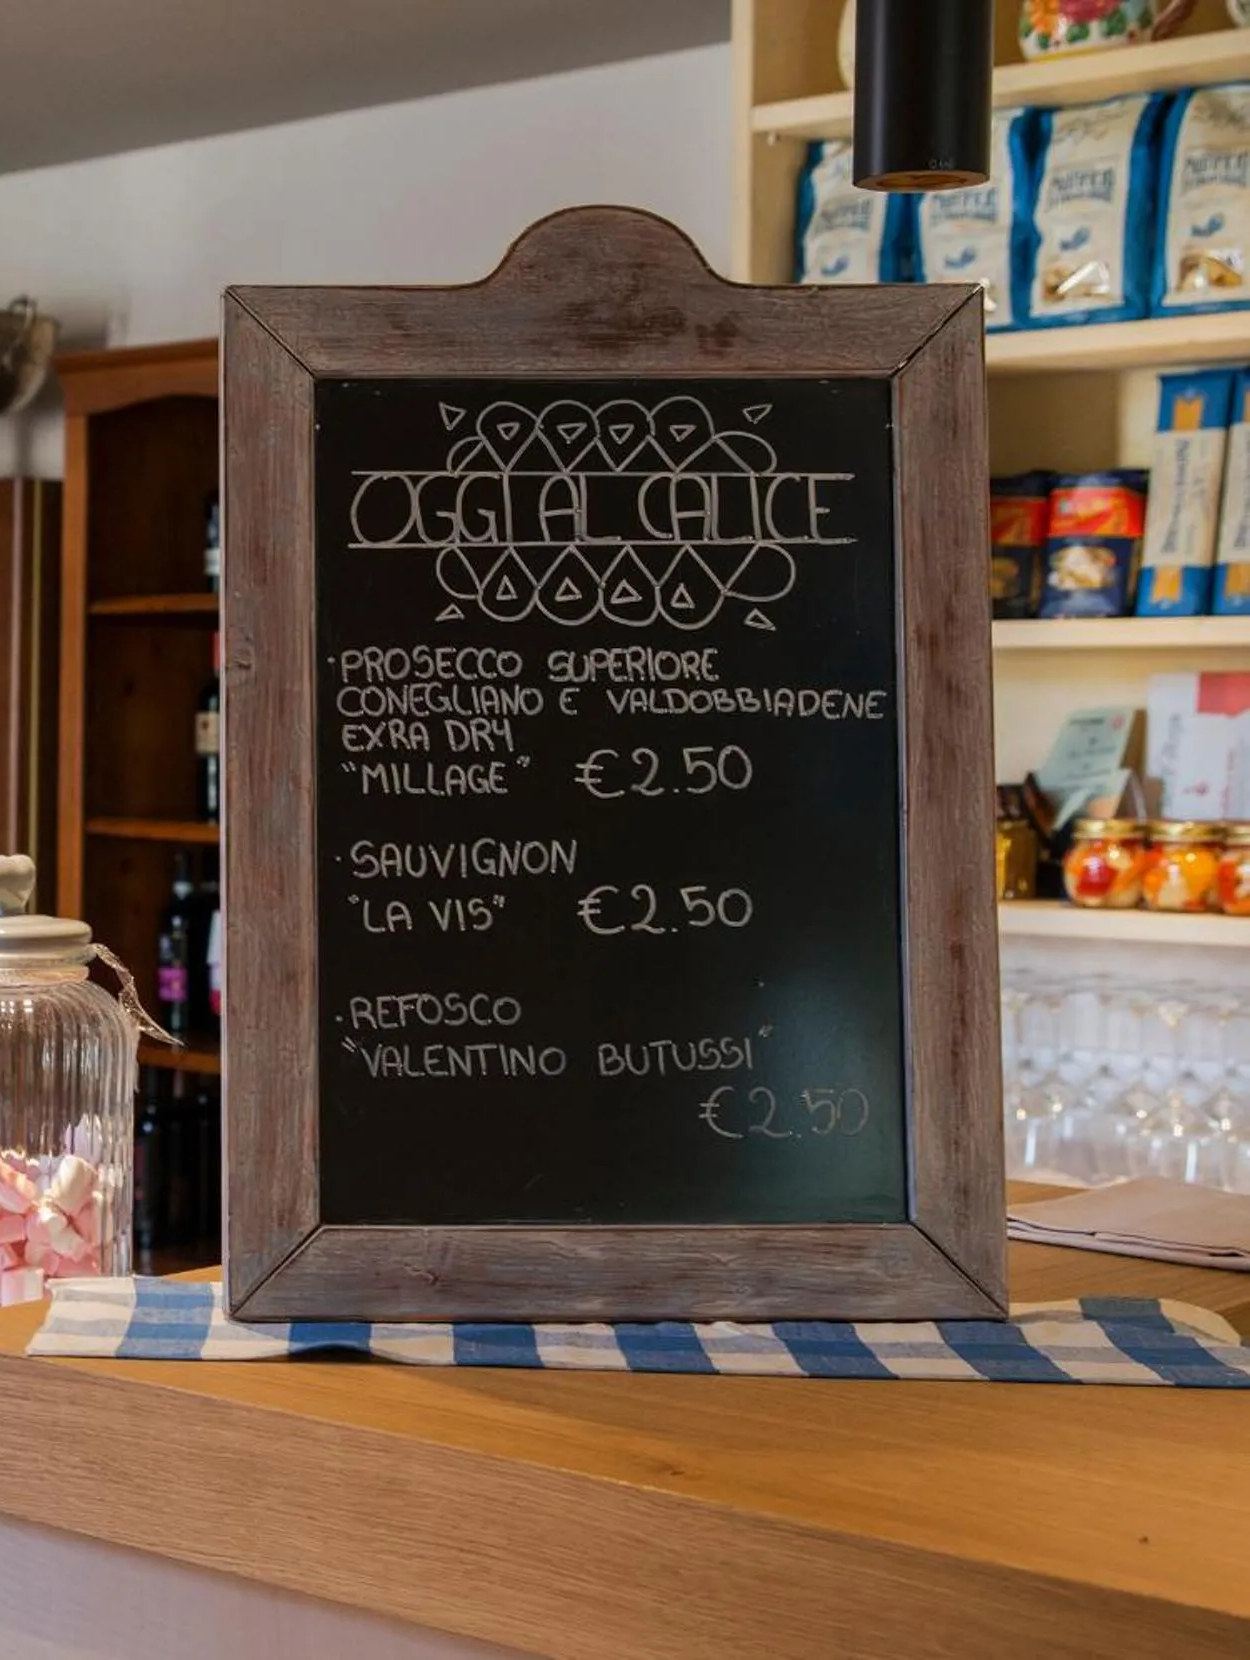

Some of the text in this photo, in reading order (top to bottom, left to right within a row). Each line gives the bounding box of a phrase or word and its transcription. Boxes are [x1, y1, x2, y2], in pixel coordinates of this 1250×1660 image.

[350, 472, 854, 546] OGGI AL CALICE
[341, 646, 719, 682] PROSECCO SUPERIORE
[337, 686, 887, 720] CONEGLIANO E VALDOBBIADENE
[350, 838, 577, 878] SAUVIGNON
[350, 993, 521, 1029] REFOSCO
